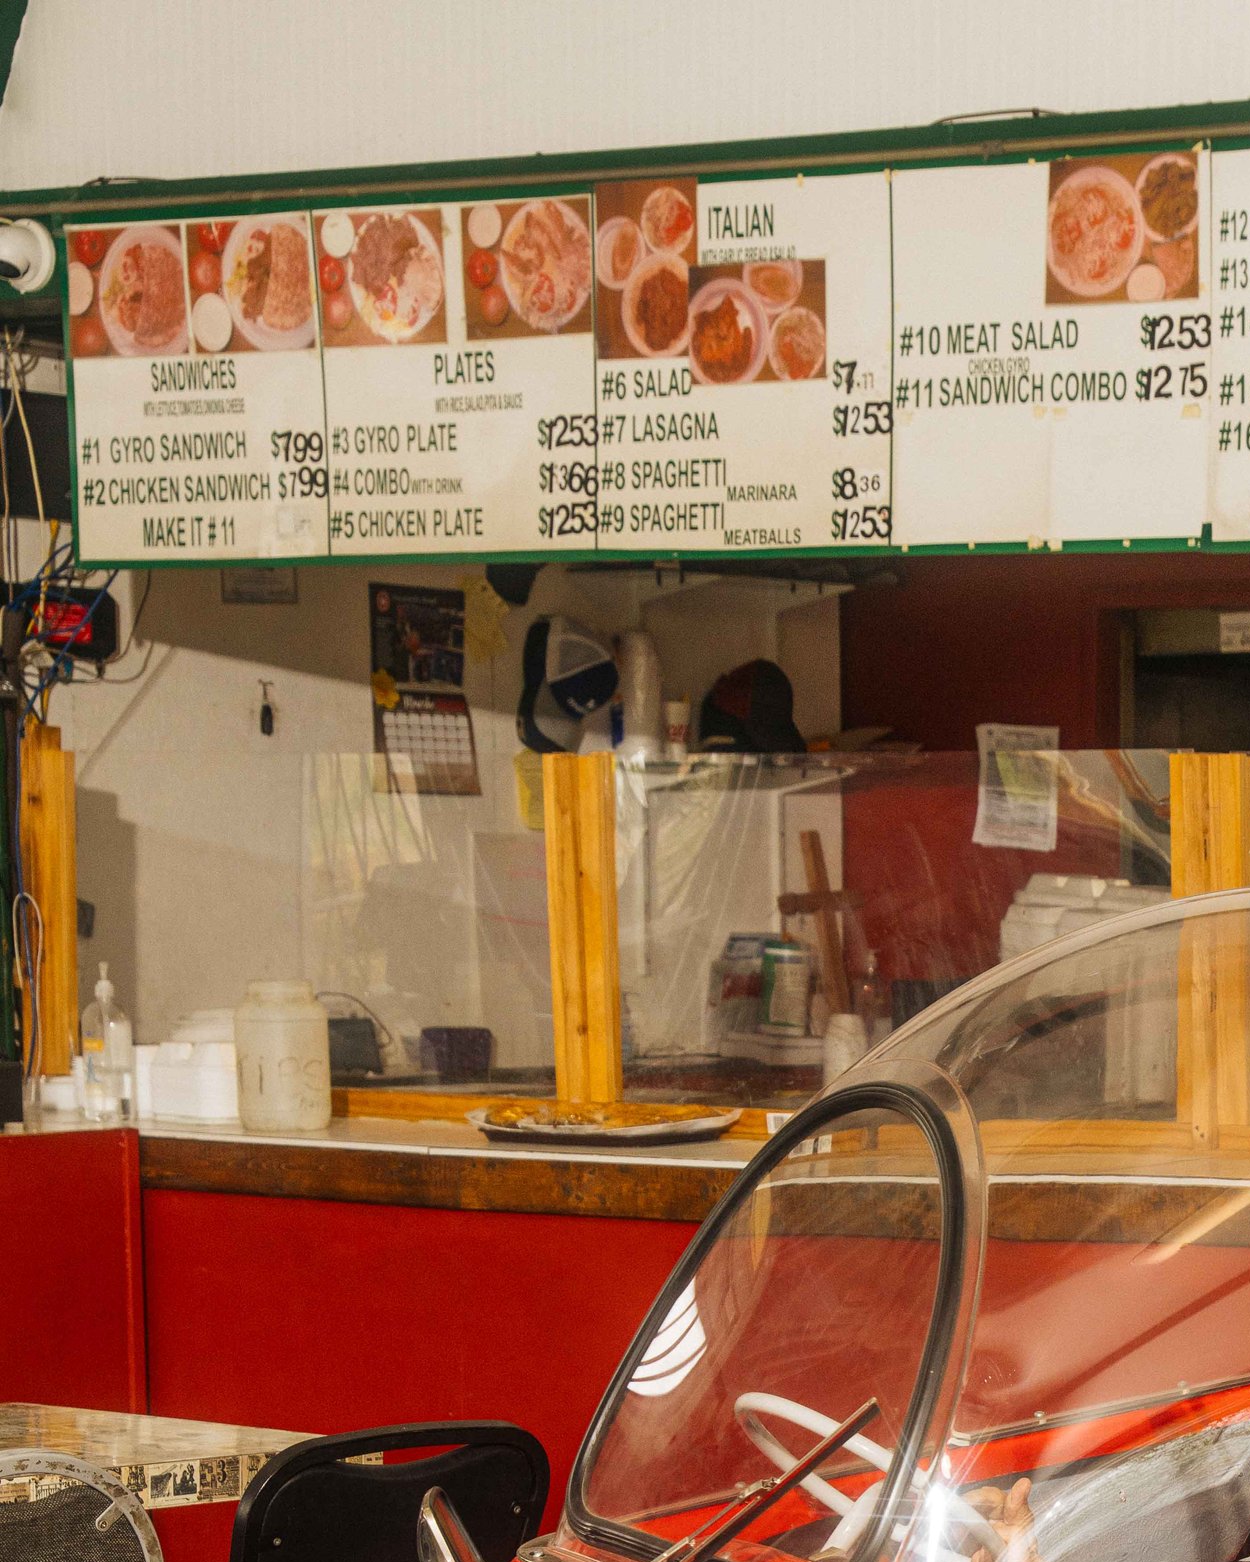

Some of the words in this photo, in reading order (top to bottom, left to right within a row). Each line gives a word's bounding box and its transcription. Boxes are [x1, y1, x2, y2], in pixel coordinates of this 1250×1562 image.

[708, 204, 774, 239] ITALIAN
[1220, 209, 1248, 241] #12
[1220, 259, 1248, 290] #13
[900, 326, 940, 356] #10
[947, 323, 1000, 355] MEAT
[1011, 320, 1078, 350] SALAD
[151, 359, 237, 391] SANDWICHES
[435, 351, 495, 385] PLATES
[602, 371, 626, 400] #6
[634, 369, 691, 397] SALAD
[896, 378, 933, 408] #11
[939, 374, 1044, 406] SANDWICH
[1051, 372, 1127, 401] COMBO
[332, 426, 349, 454] #3
[354, 425, 399, 454] GYRO
[407, 423, 457, 452] PLATE
[603, 415, 626, 443] #7
[633, 412, 719, 442] LASAGNA
[82, 438, 100, 464] #1
[110, 436, 154, 463] GYRO
[160, 431, 246, 460] SANDWICH
[84, 479, 106, 506] #2
[109, 477, 179, 504] CHICKEN
[185, 473, 271, 502] SANDWICH
[333, 469, 349, 494] #4
[354, 468, 410, 495] COMBO
[410, 479, 433, 494] WITH
[435, 478, 463, 494] DRINK
[602, 461, 625, 489] #8
[632, 459, 726, 488] SPAGHETTI
[727, 484, 797, 501] MARINARA
[143, 517, 186, 547] MAKE
[191, 517, 203, 545] IT
[331, 512, 354, 539] #5
[359, 510, 426, 537] CHICKEN
[433, 508, 483, 536] PLATE
[600, 505, 624, 533] #9
[630, 503, 724, 532] SPAGHETTI
[724, 528, 801, 545] MEATBALLS
